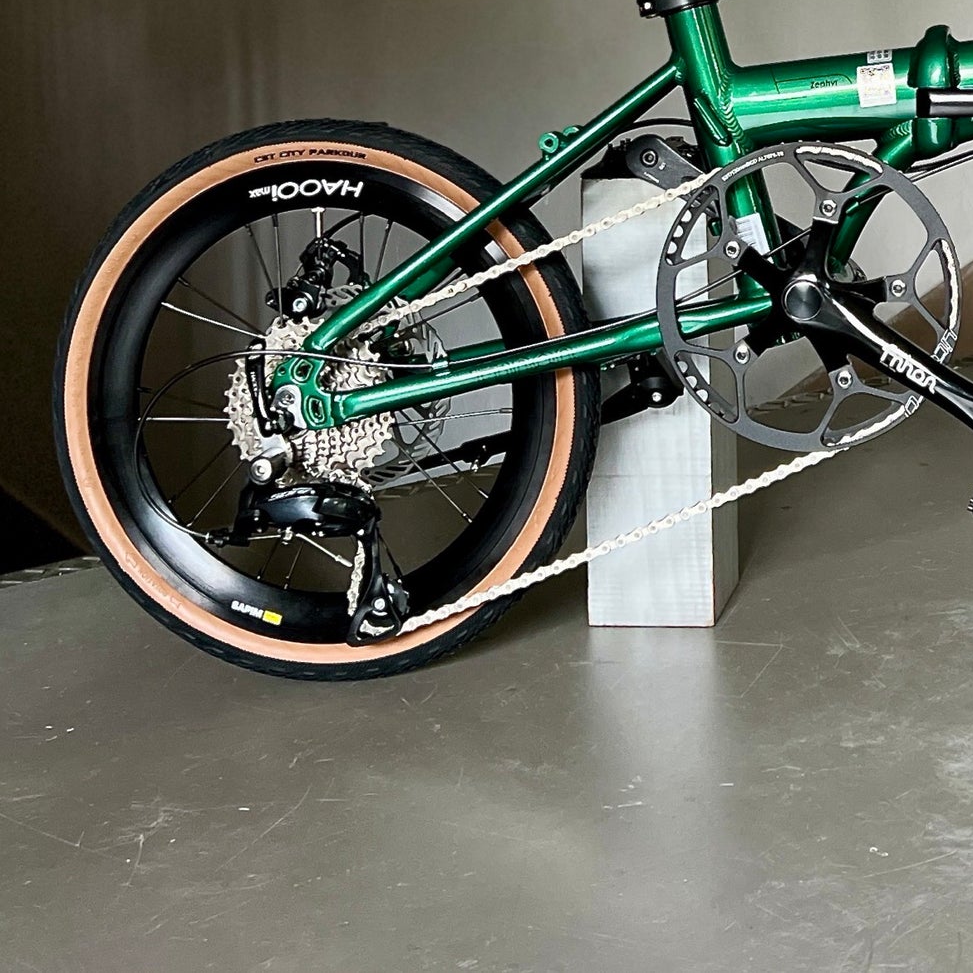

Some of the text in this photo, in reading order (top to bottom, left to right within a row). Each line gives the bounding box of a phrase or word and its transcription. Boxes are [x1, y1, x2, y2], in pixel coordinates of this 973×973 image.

[810, 79, 838, 89] Zephyr
[279, 149, 306, 159] CITY
[309, 149, 367, 160] PARKOUR
